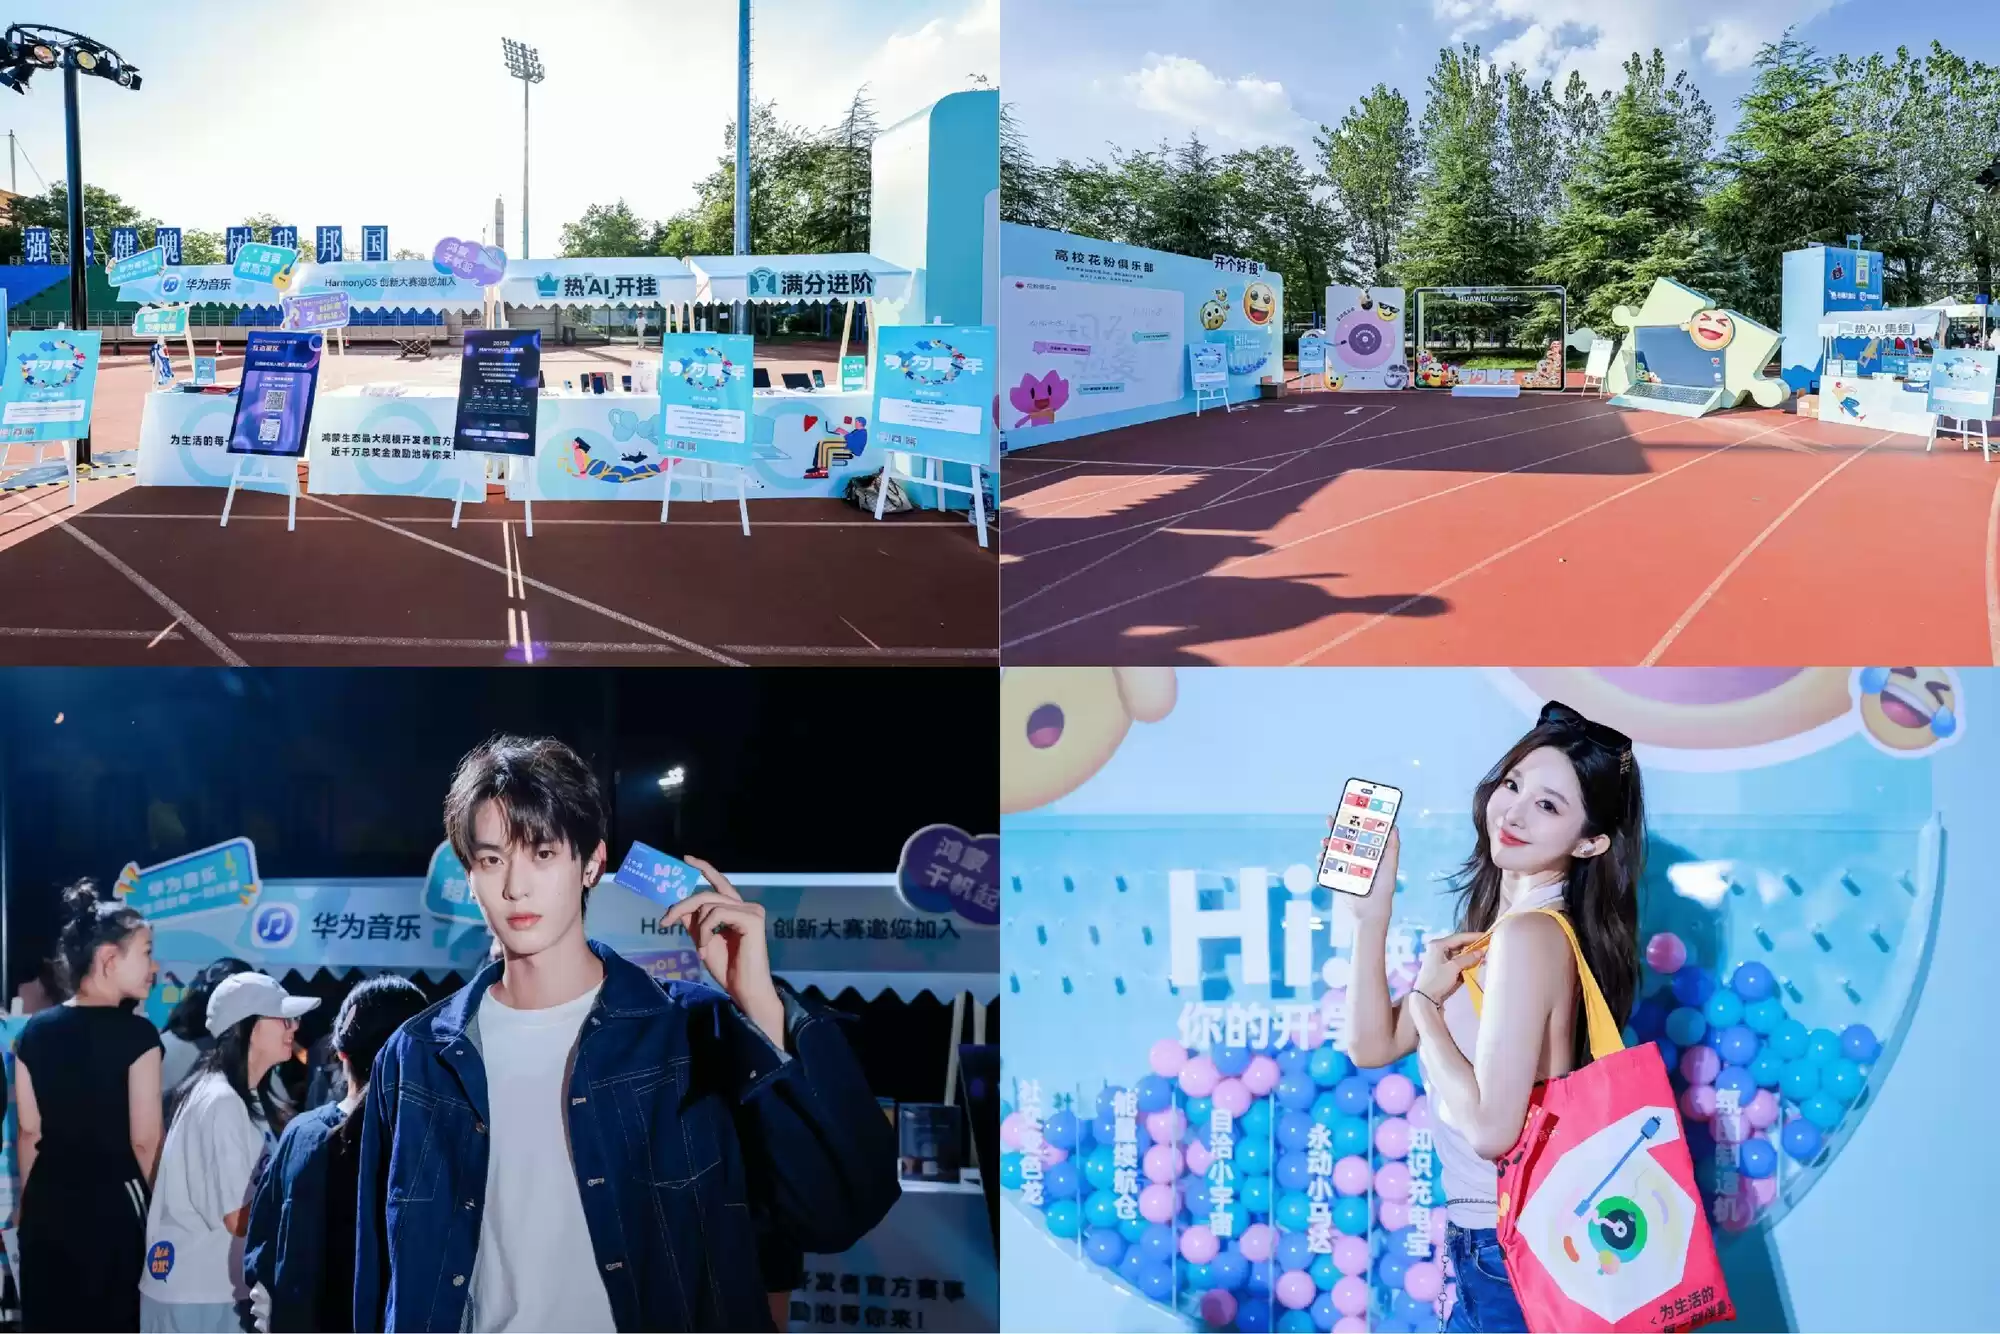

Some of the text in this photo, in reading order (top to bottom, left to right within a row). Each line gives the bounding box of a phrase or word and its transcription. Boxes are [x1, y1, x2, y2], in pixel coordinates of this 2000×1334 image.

[1054, 249, 1155, 273] 高校花粉俱乐部
[186, 278, 231, 291] 华为音乐
[324, 274, 457, 288] HarmonyOS 创新大赛邀您加入
[780, 272, 874, 295] 满分进阶
[1458, 295, 1489, 303] HUAWEI
[321, 432, 456, 447] 鸿蒙生态最大规模开发者官方
[312, 913, 421, 941] 华为音乐
[772, 917, 960, 941] 创新大赛邀您加入
[1307, 1123, 1333, 1253] 永动小马达
[1660, 1286, 1714, 1323] 为生活的
